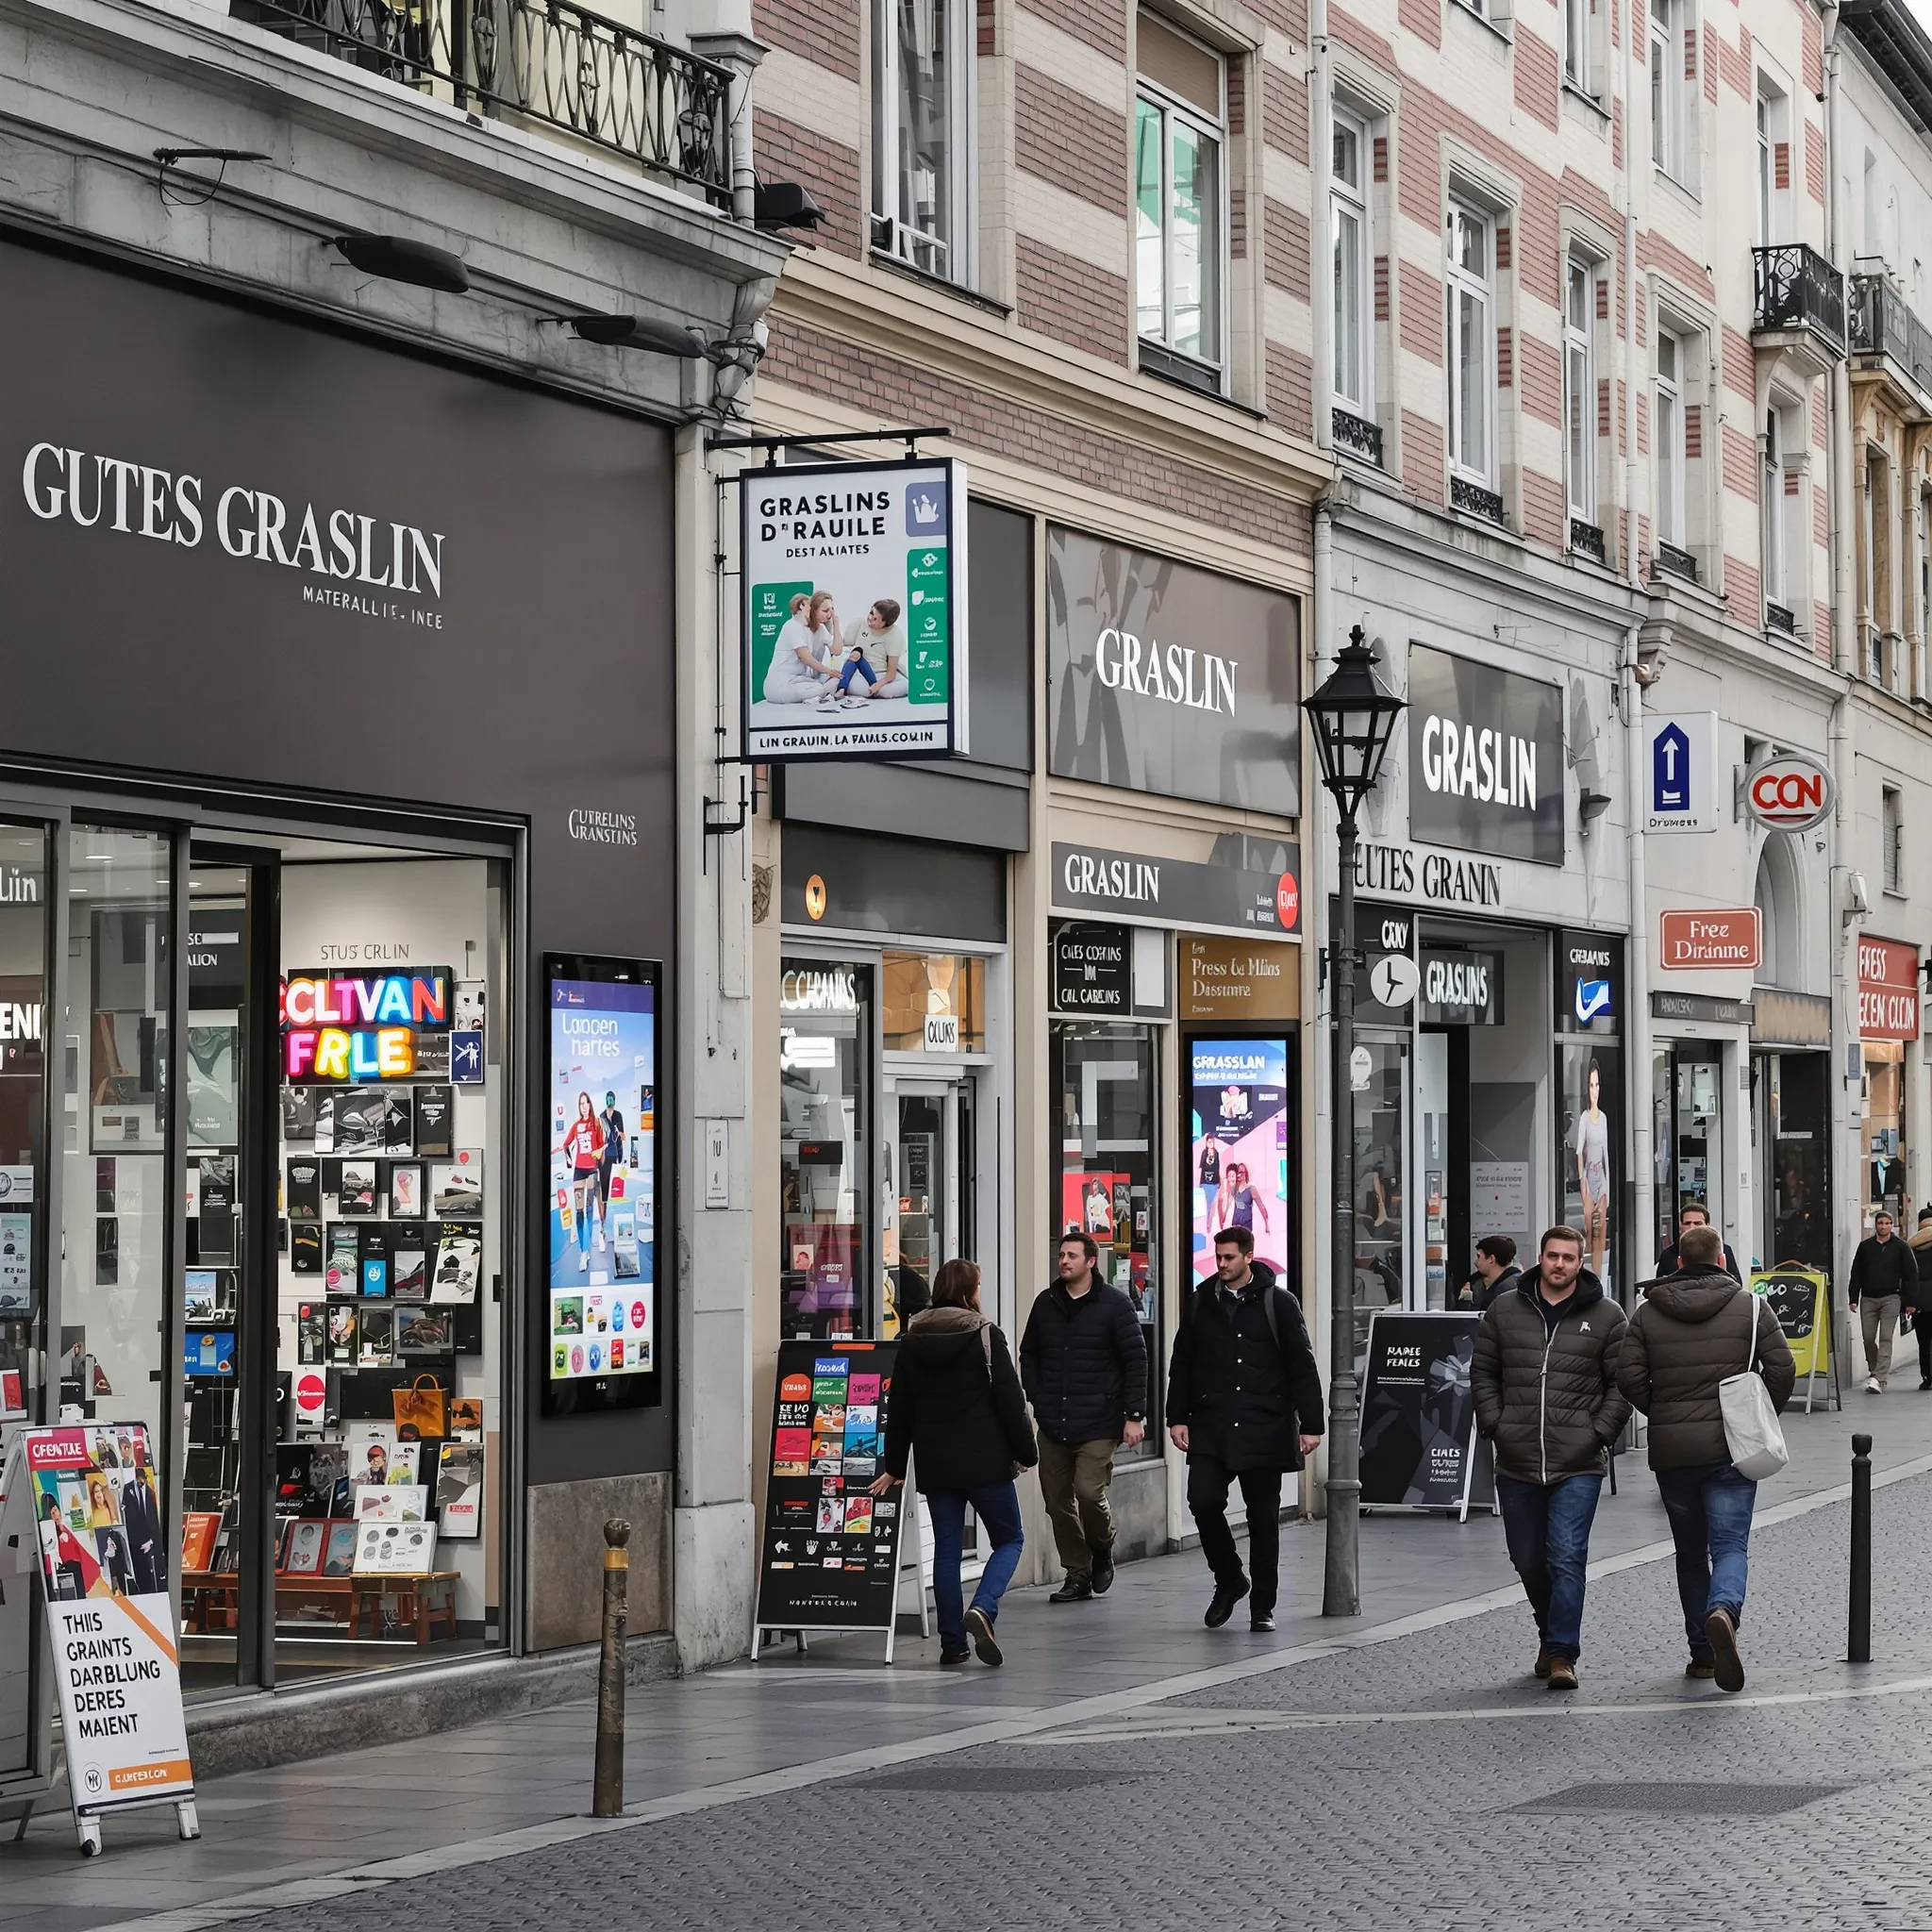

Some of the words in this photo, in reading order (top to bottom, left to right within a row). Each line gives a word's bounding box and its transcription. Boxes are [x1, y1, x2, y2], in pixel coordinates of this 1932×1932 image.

[23, 442, 203, 547] GUTES
[217, 486, 446, 599] GRASLIN
[760, 491, 890, 517] GRASLINS
[1095, 627, 1239, 718] GRASLIN
[759, 738, 779, 748] LIN
[1422, 714, 1537, 811] GRASLIN
[1064, 854, 1160, 903] GRASLIN
[1426, 960, 1488, 1008] GRASLINS
[67, 1637, 132, 1661] GRAINTS
[75, 1690, 125, 1712] DERES
[78, 1713, 139, 1739] MAIENT
